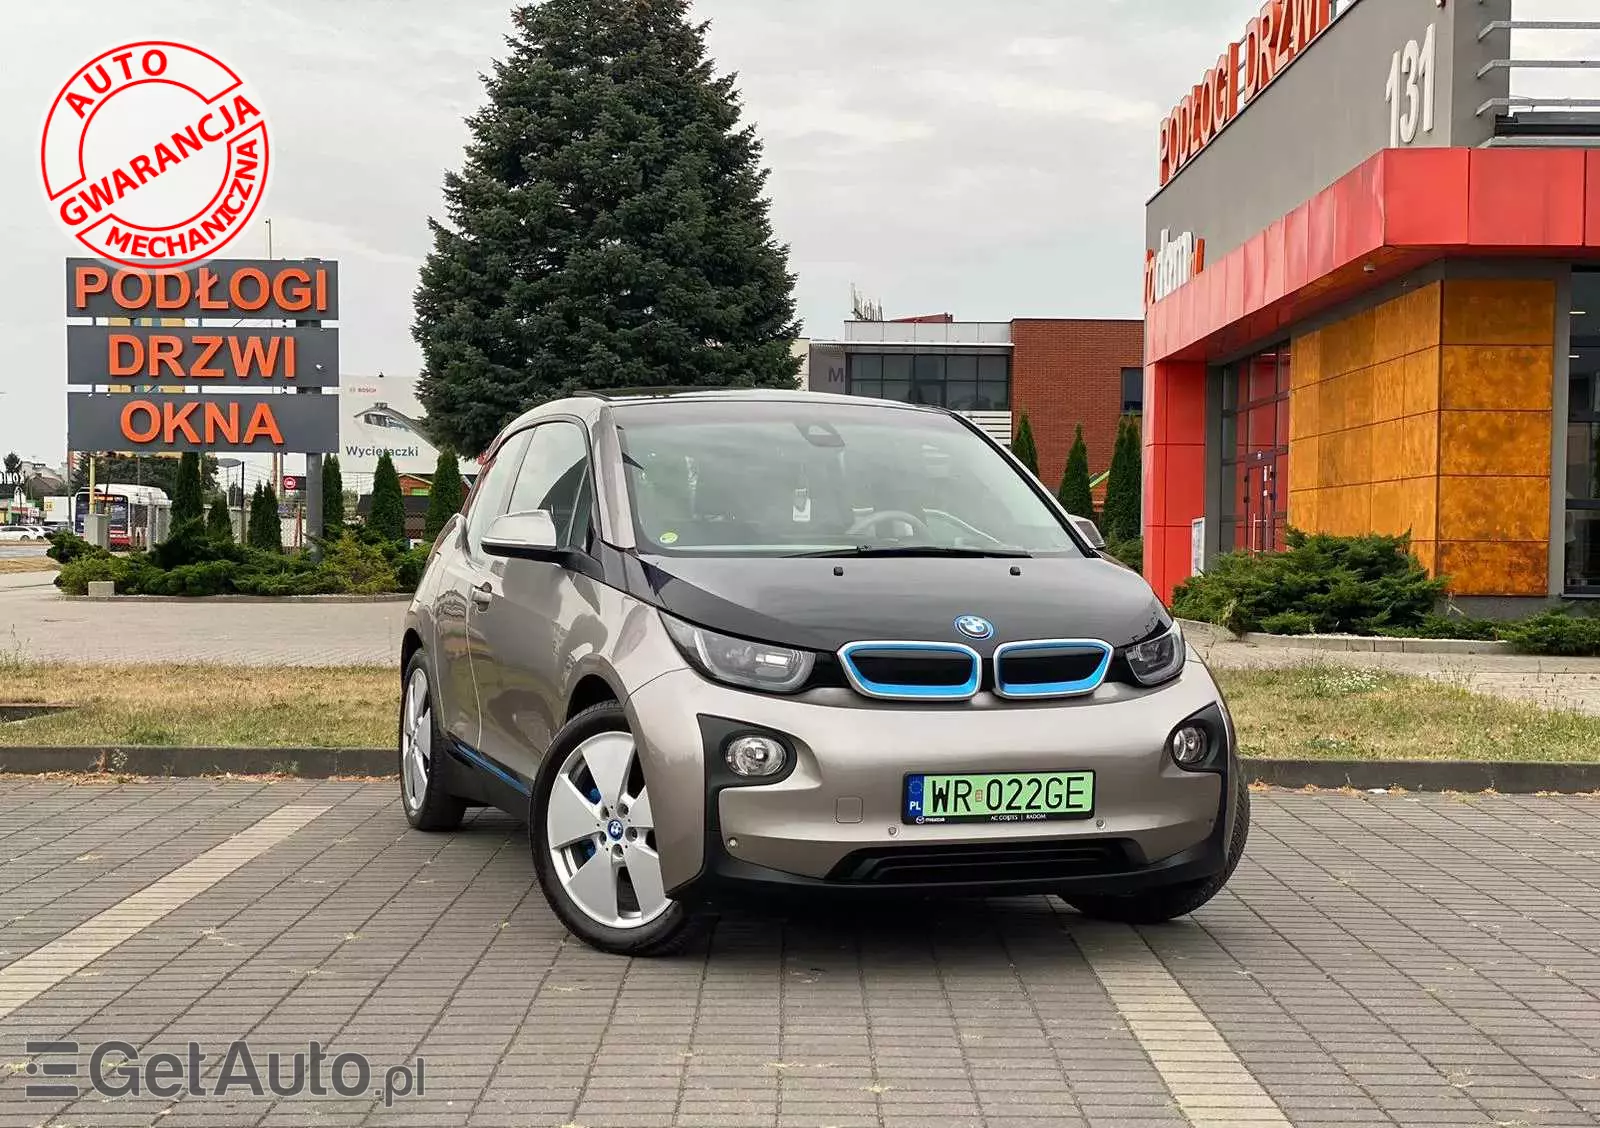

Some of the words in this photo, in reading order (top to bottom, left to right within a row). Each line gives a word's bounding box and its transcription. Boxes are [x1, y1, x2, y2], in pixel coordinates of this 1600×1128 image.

[1385, 24, 1437, 147] 131
[1160, 43, 1240, 187] PODŁOGI
[75, 267, 328, 312] PODŁOGI
[108, 333, 297, 378] DRZWI
[120, 399, 284, 446] OKNA
[909, 800, 922, 811] PL
[932, 780, 972, 812] WR
[986, 776, 1085, 811] 022GE
